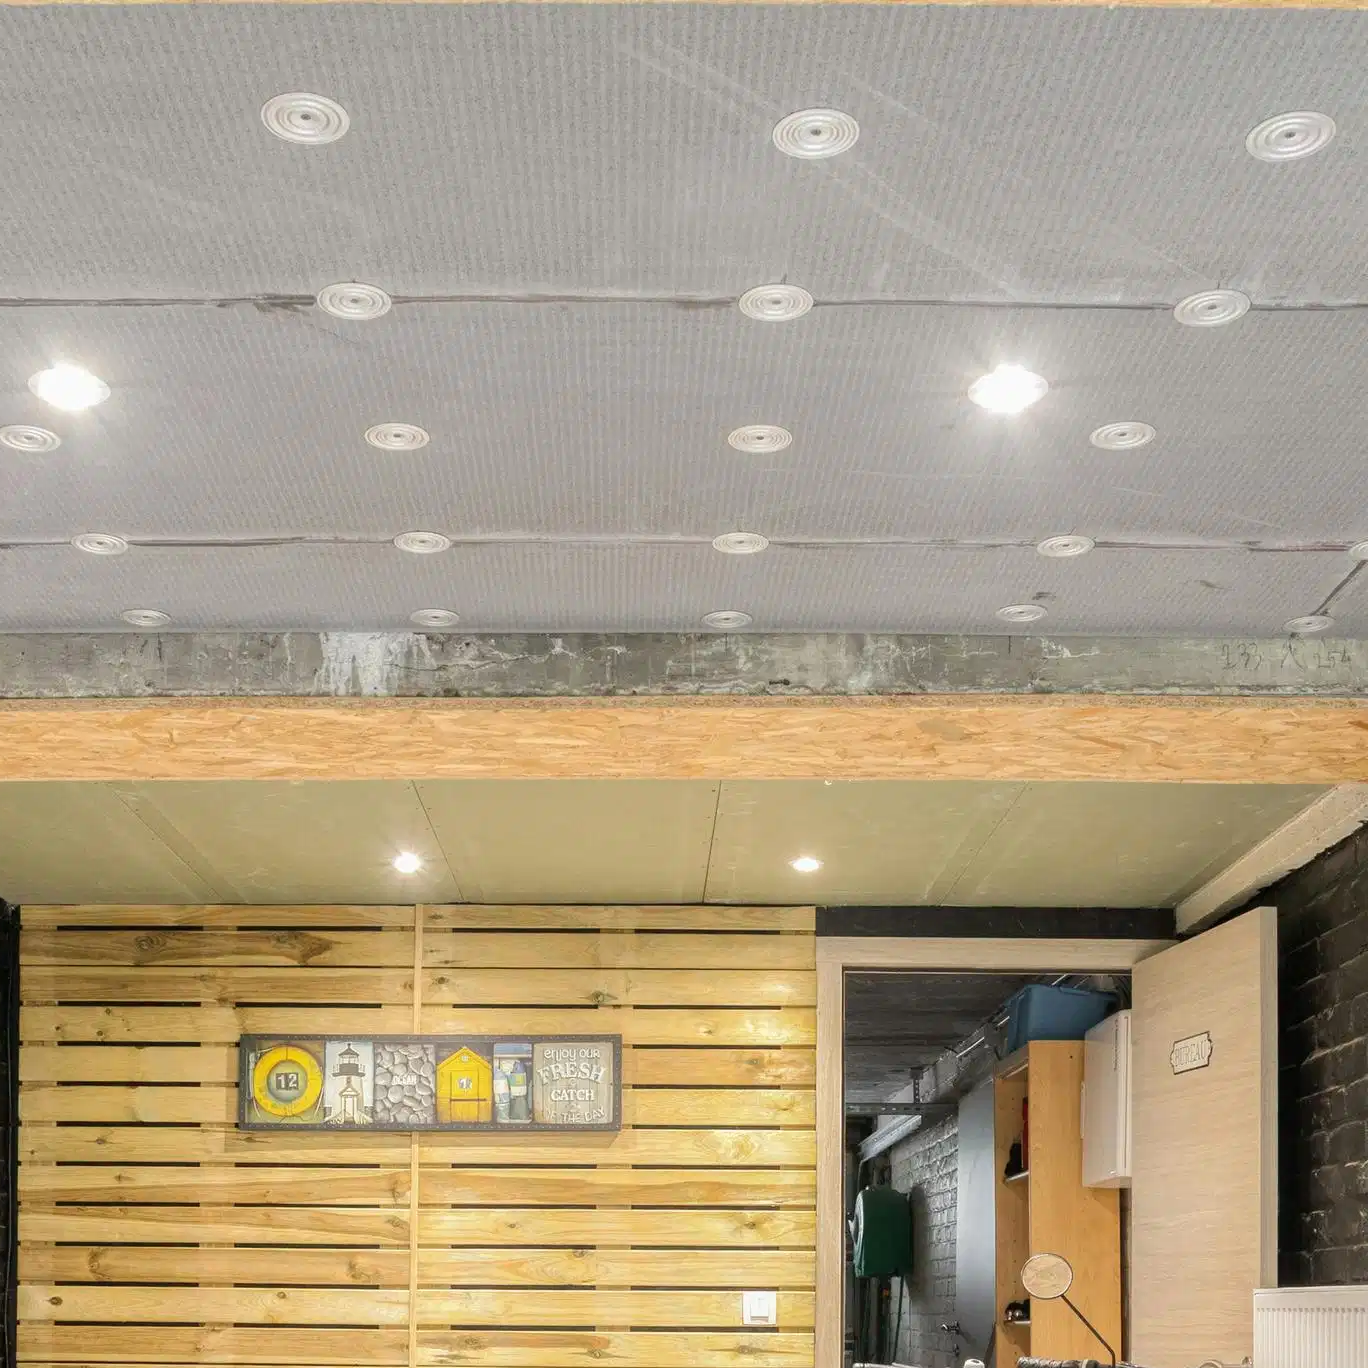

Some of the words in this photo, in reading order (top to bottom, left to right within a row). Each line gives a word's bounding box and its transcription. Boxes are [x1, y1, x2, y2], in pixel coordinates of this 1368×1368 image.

[544, 1048, 576, 1061] enjoy
[1174, 1040, 1207, 1066] BUREAU
[277, 1073, 297, 1088] 12
[537, 1062, 607, 1085] FRESH
[551, 1089, 594, 1101] CATCH
[584, 1105, 605, 1121] DAY
